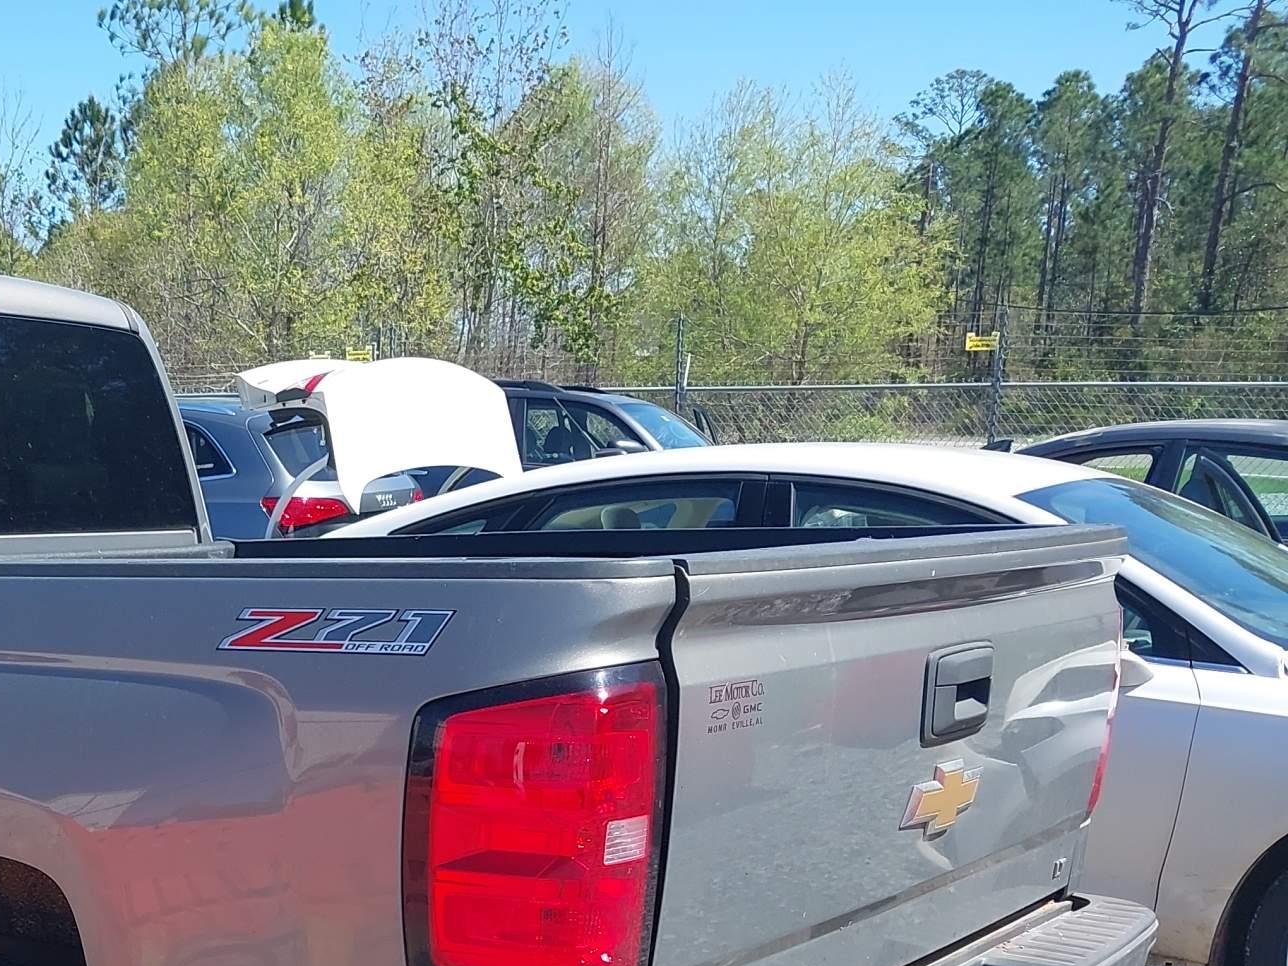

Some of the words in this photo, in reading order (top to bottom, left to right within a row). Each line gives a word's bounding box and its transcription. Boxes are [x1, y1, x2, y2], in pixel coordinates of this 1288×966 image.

[216, 607, 457, 654] Z71
[345, 643, 378, 652] OFF
[383, 643, 427, 653] ROAD
[743, 702, 763, 714] GMC
